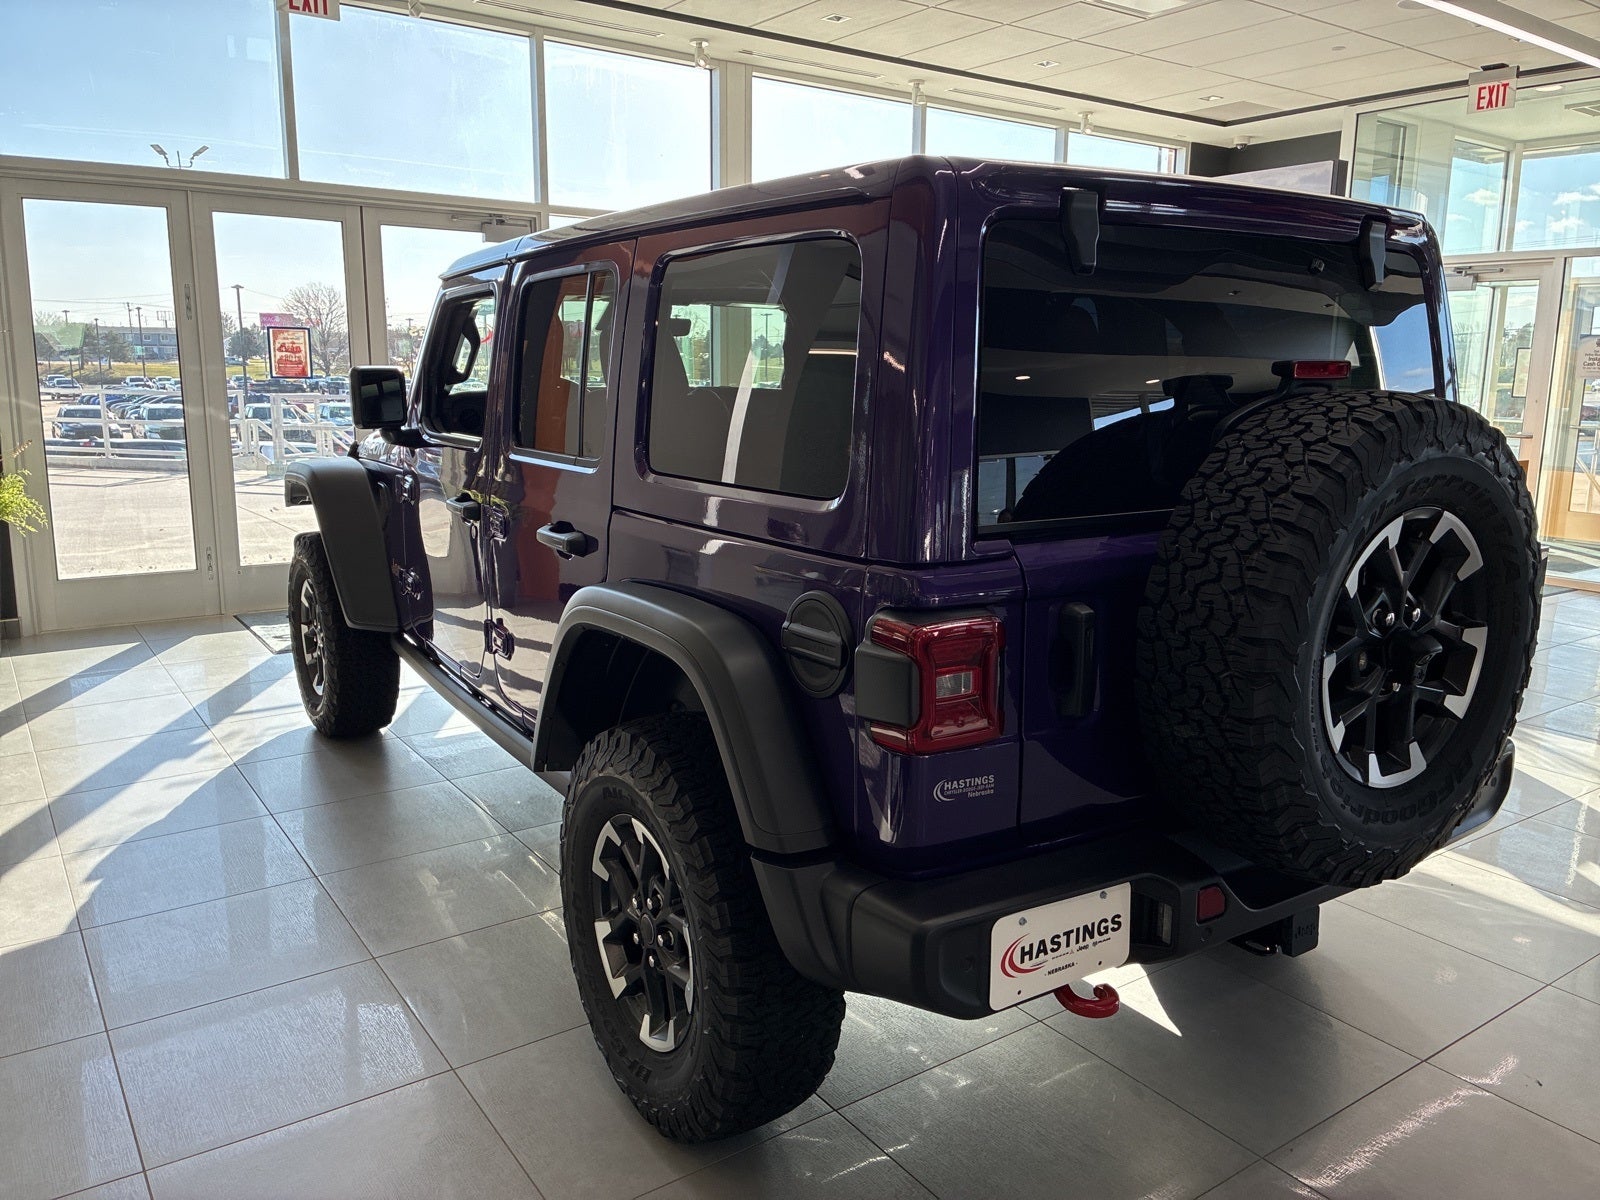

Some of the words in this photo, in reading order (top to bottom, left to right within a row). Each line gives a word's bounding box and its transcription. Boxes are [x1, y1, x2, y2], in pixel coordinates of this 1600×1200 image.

[1477, 82, 1509, 110] EXIT
[944, 775, 995, 790] HASTINGS
[1020, 913, 1122, 965] HASTINGS
[1047, 962, 1075, 976] NEBRASKA
